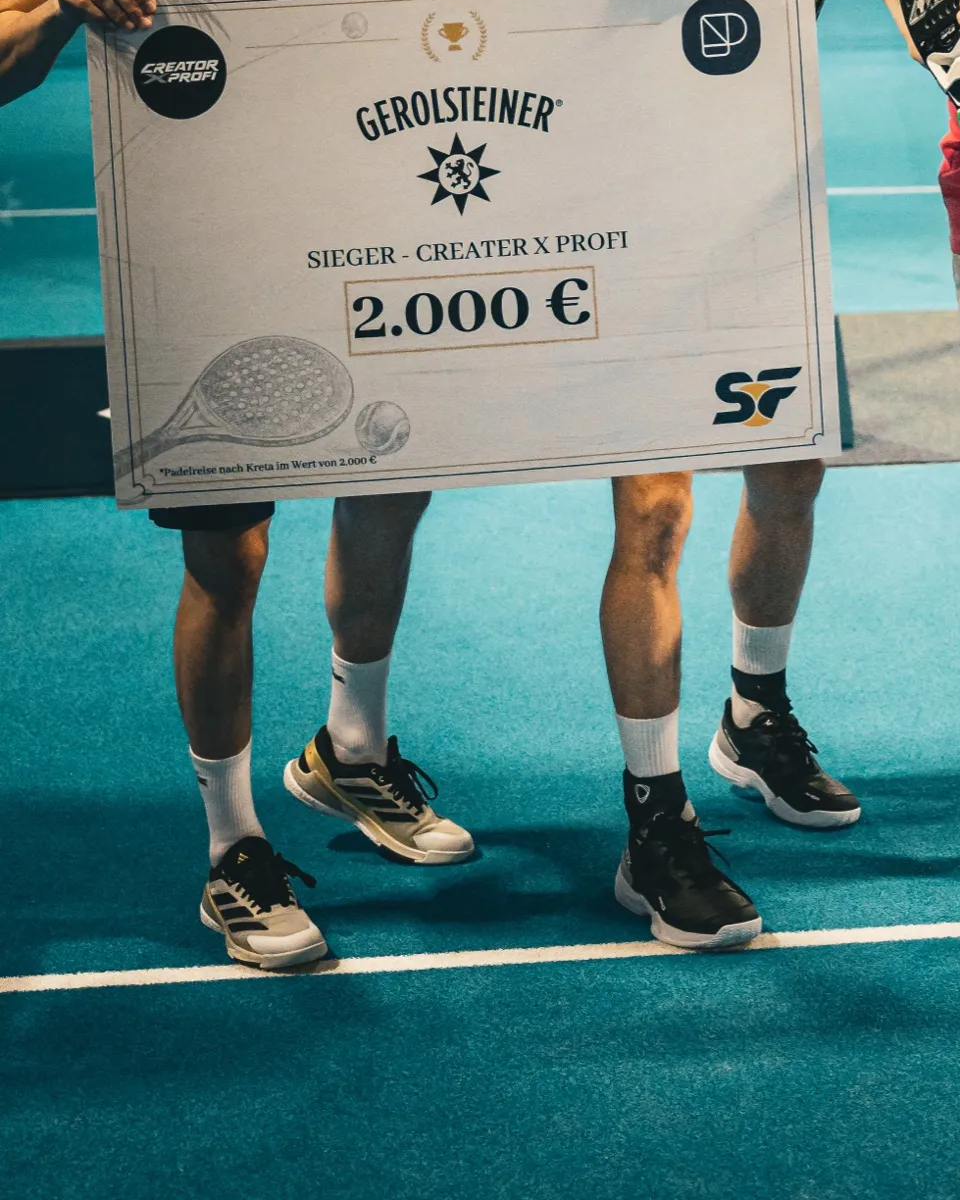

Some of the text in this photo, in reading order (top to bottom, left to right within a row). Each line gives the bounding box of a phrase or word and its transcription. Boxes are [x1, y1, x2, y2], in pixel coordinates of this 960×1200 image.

[140, 59, 219, 74] CREATOR
[168, 71, 218, 83] PROFI
[307, 246, 397, 269] SIEGER
[416, 238, 528, 263] CREATER
[532, 236, 550, 256] X
[555, 230, 629, 253] PROFI
[352, 277, 591, 339] 2.000 €
[219, 462, 244, 474] nach
[246, 462, 274, 473] Kreta
[275, 461, 290, 471] im
[290, 460, 316, 469] Wert
[317, 459, 337, 468] von
[339, 457, 368, 467] 2.000
[369, 455, 377, 465] €
